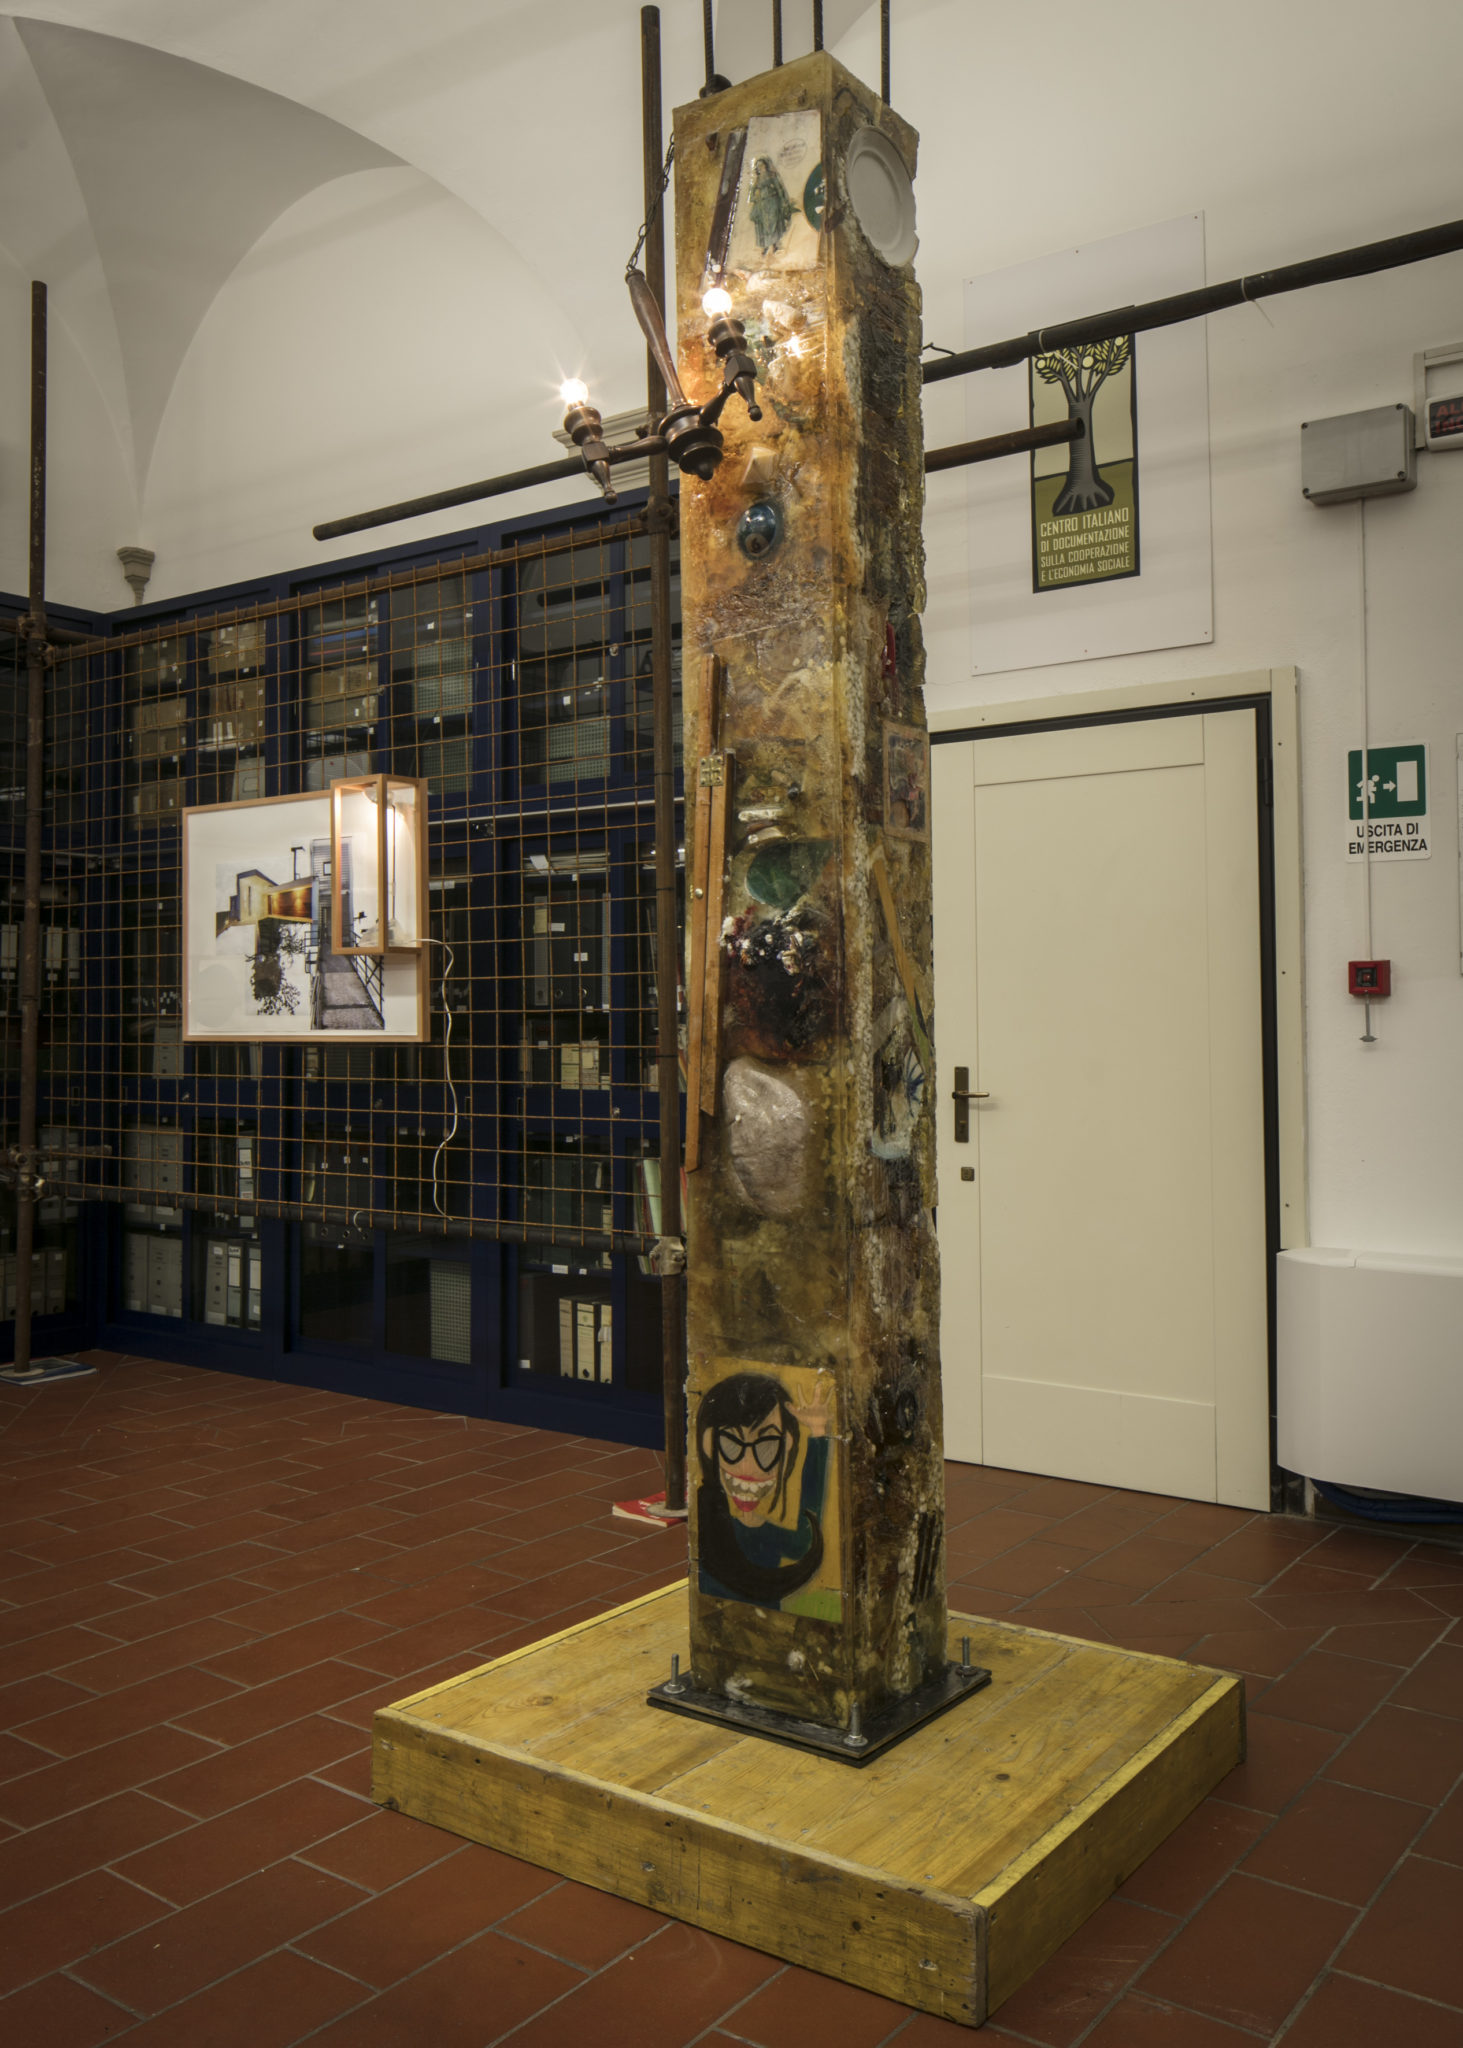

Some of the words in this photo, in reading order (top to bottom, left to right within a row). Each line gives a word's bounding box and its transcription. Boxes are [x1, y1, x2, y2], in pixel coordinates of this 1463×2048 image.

[1040, 517, 1078, 537] CENTRO
[1082, 507, 1129, 530] ITALIANO
[1040, 540, 1050, 553] DI
[1052, 525, 1130, 551] DOCUMENTAZIONE
[1040, 553, 1065, 568] SULLA
[1068, 541, 1129, 563] COOPERAZIONE
[1041, 570, 1046, 582] E
[1048, 562, 1095, 581] L'ECONOMIA
[1097, 556, 1130, 572] SOCIALE
[1357, 824, 1402, 838] USCITA
[1406, 822, 1419, 835] DI
